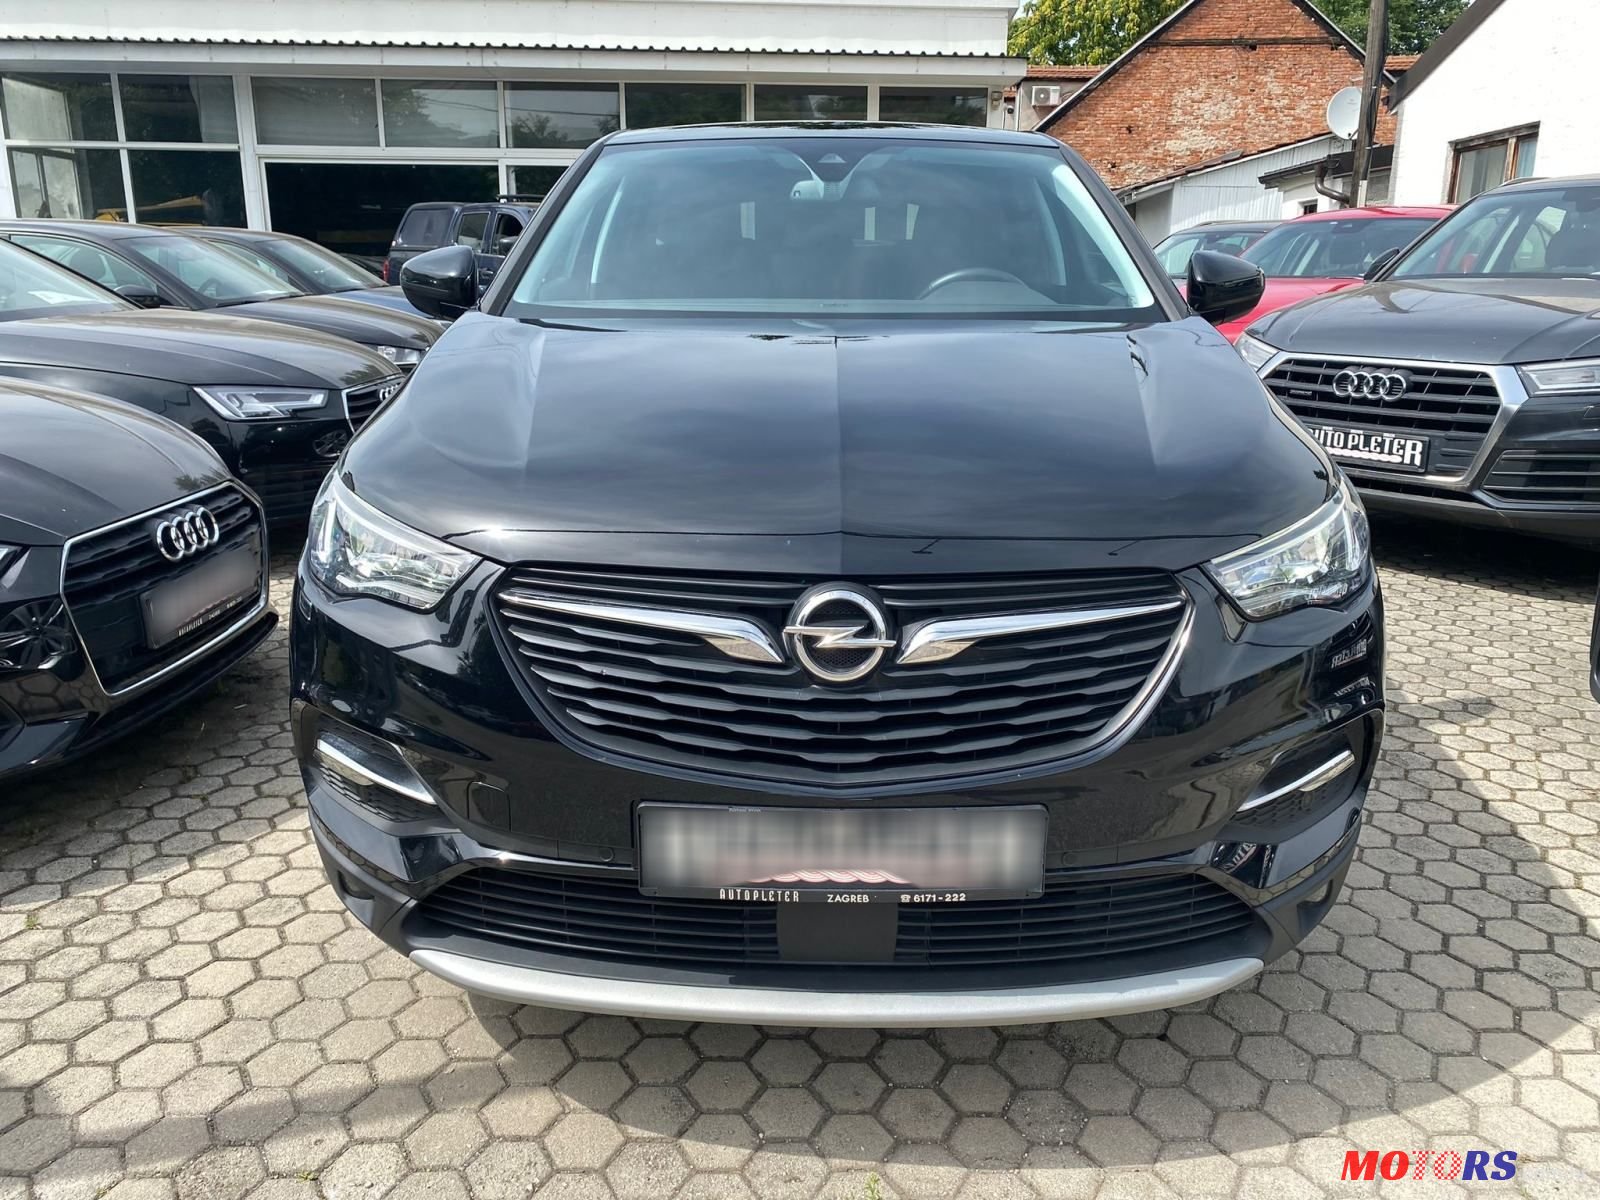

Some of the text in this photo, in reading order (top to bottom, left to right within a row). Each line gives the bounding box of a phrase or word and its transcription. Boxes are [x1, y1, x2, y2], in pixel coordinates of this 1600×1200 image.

[1347, 433, 1423, 466] PLETER
[719, 888, 967, 904] AUTOPLETER ZAGREB 6171-222
